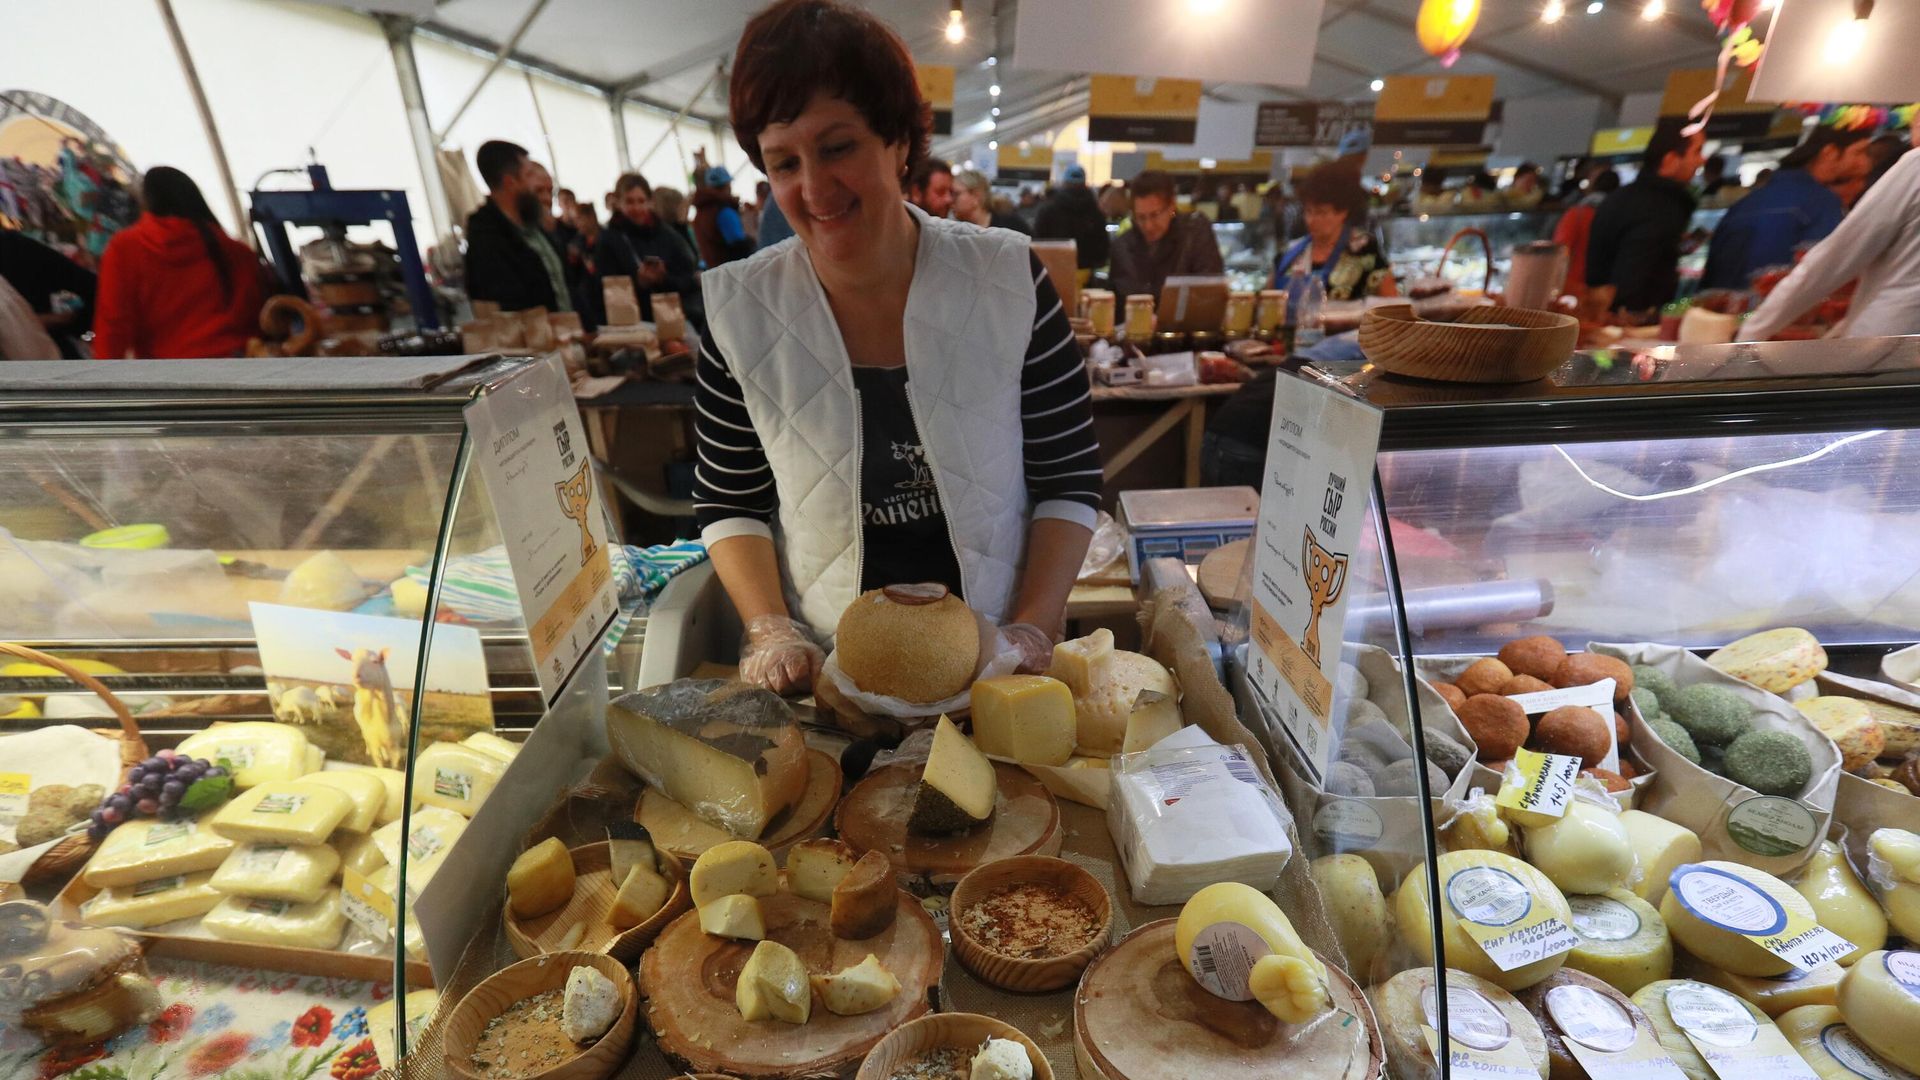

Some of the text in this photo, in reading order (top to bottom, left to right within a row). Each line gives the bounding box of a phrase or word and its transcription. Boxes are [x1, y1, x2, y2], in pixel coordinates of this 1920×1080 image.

[1280, 417, 1303, 437] ДИПЛОМ
[493, 427, 519, 456] ДИПЛОМ
[557, 431, 571, 457] СЫР
[1328, 472, 1346, 492] ЛУЧШИЙ
[1323, 487, 1342, 518] СЫР
[1320, 515, 1338, 538] РОССИИ
[1462, 895, 1477, 906] СЫР
[1702, 887, 1737, 905] ТВЕРДЫЙ
[1509, 918, 1557, 943] КАЧОТТА
